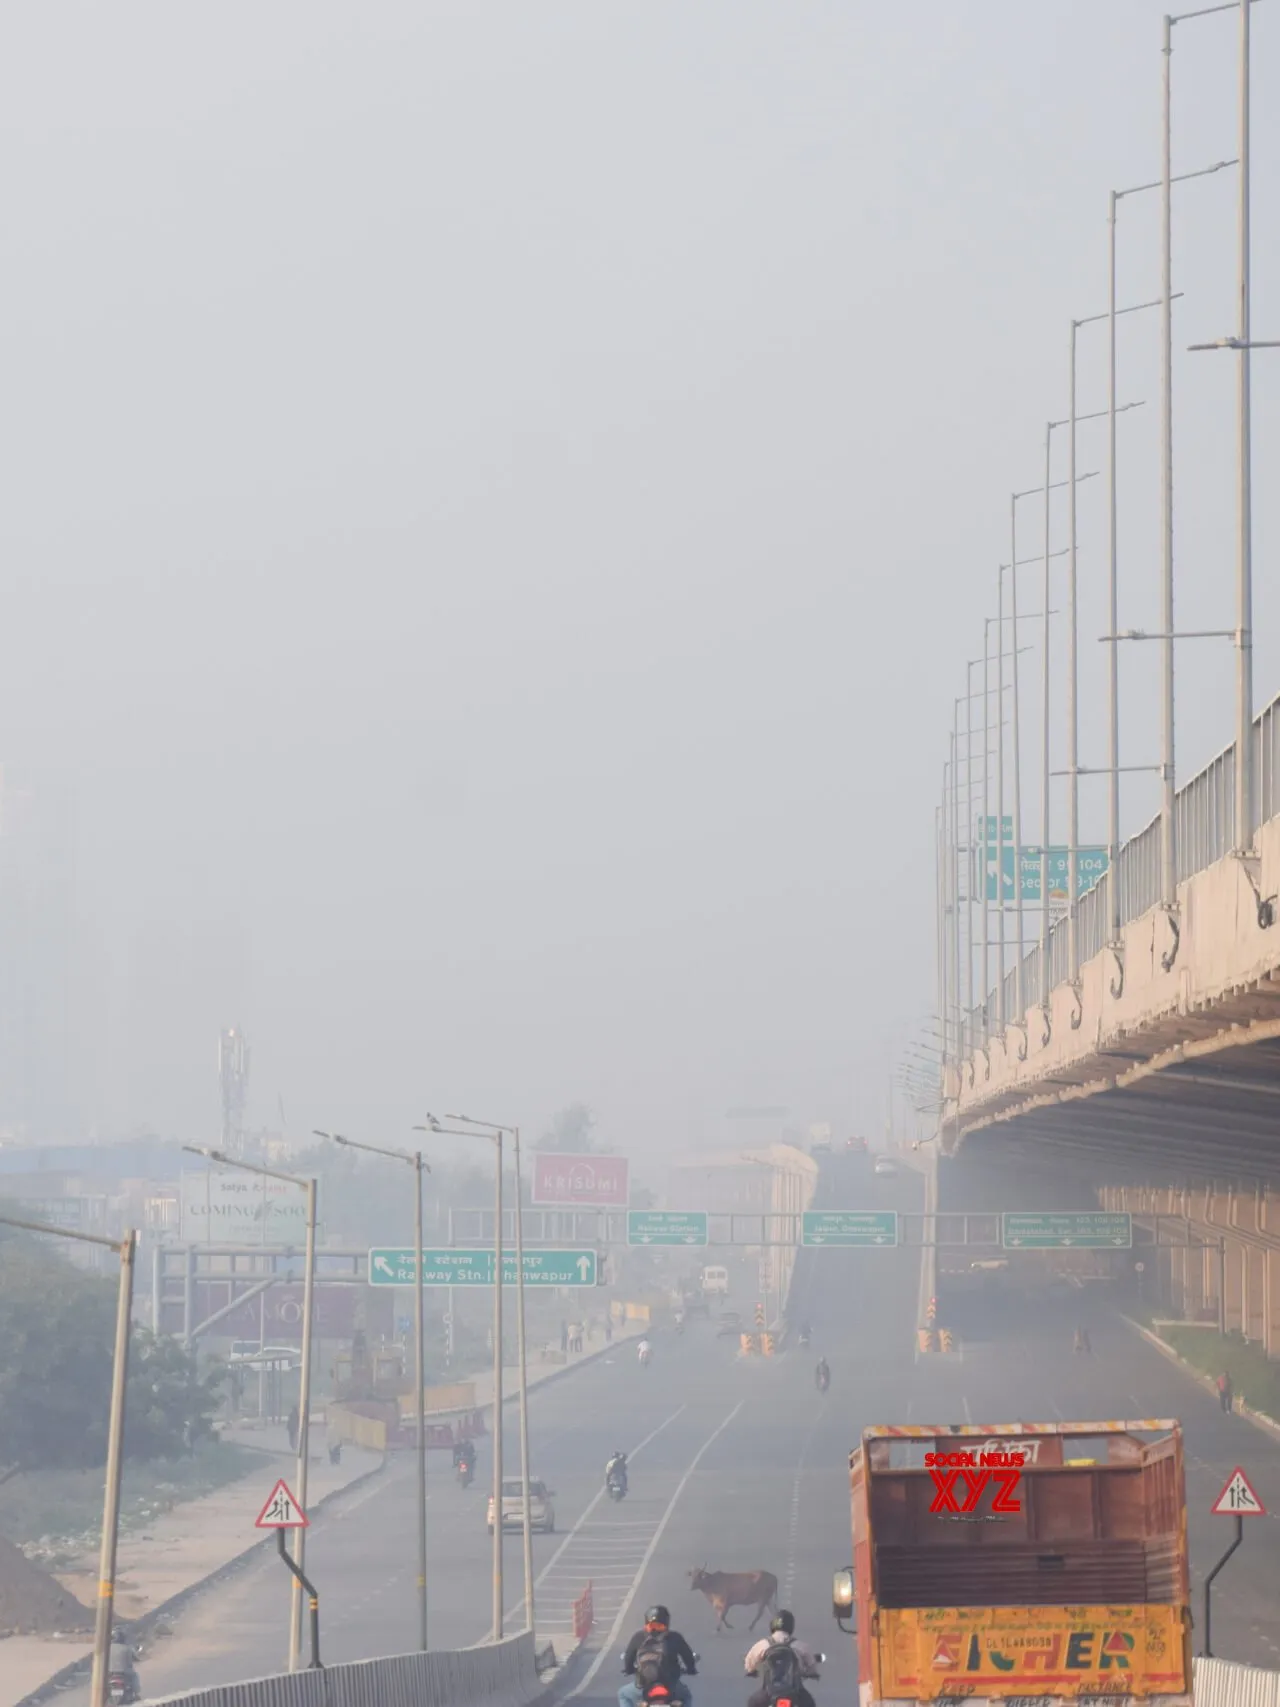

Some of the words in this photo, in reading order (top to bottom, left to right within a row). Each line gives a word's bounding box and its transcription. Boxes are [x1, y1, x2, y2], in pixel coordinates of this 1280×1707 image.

[1019, 876, 1060, 889] Secor
[543, 1174, 618, 1191] KRISUMI
[273, 1204, 306, 1217] SOO
[397, 1269, 453, 1281] Raway
[494, 1269, 573, 1282] hanwapur
